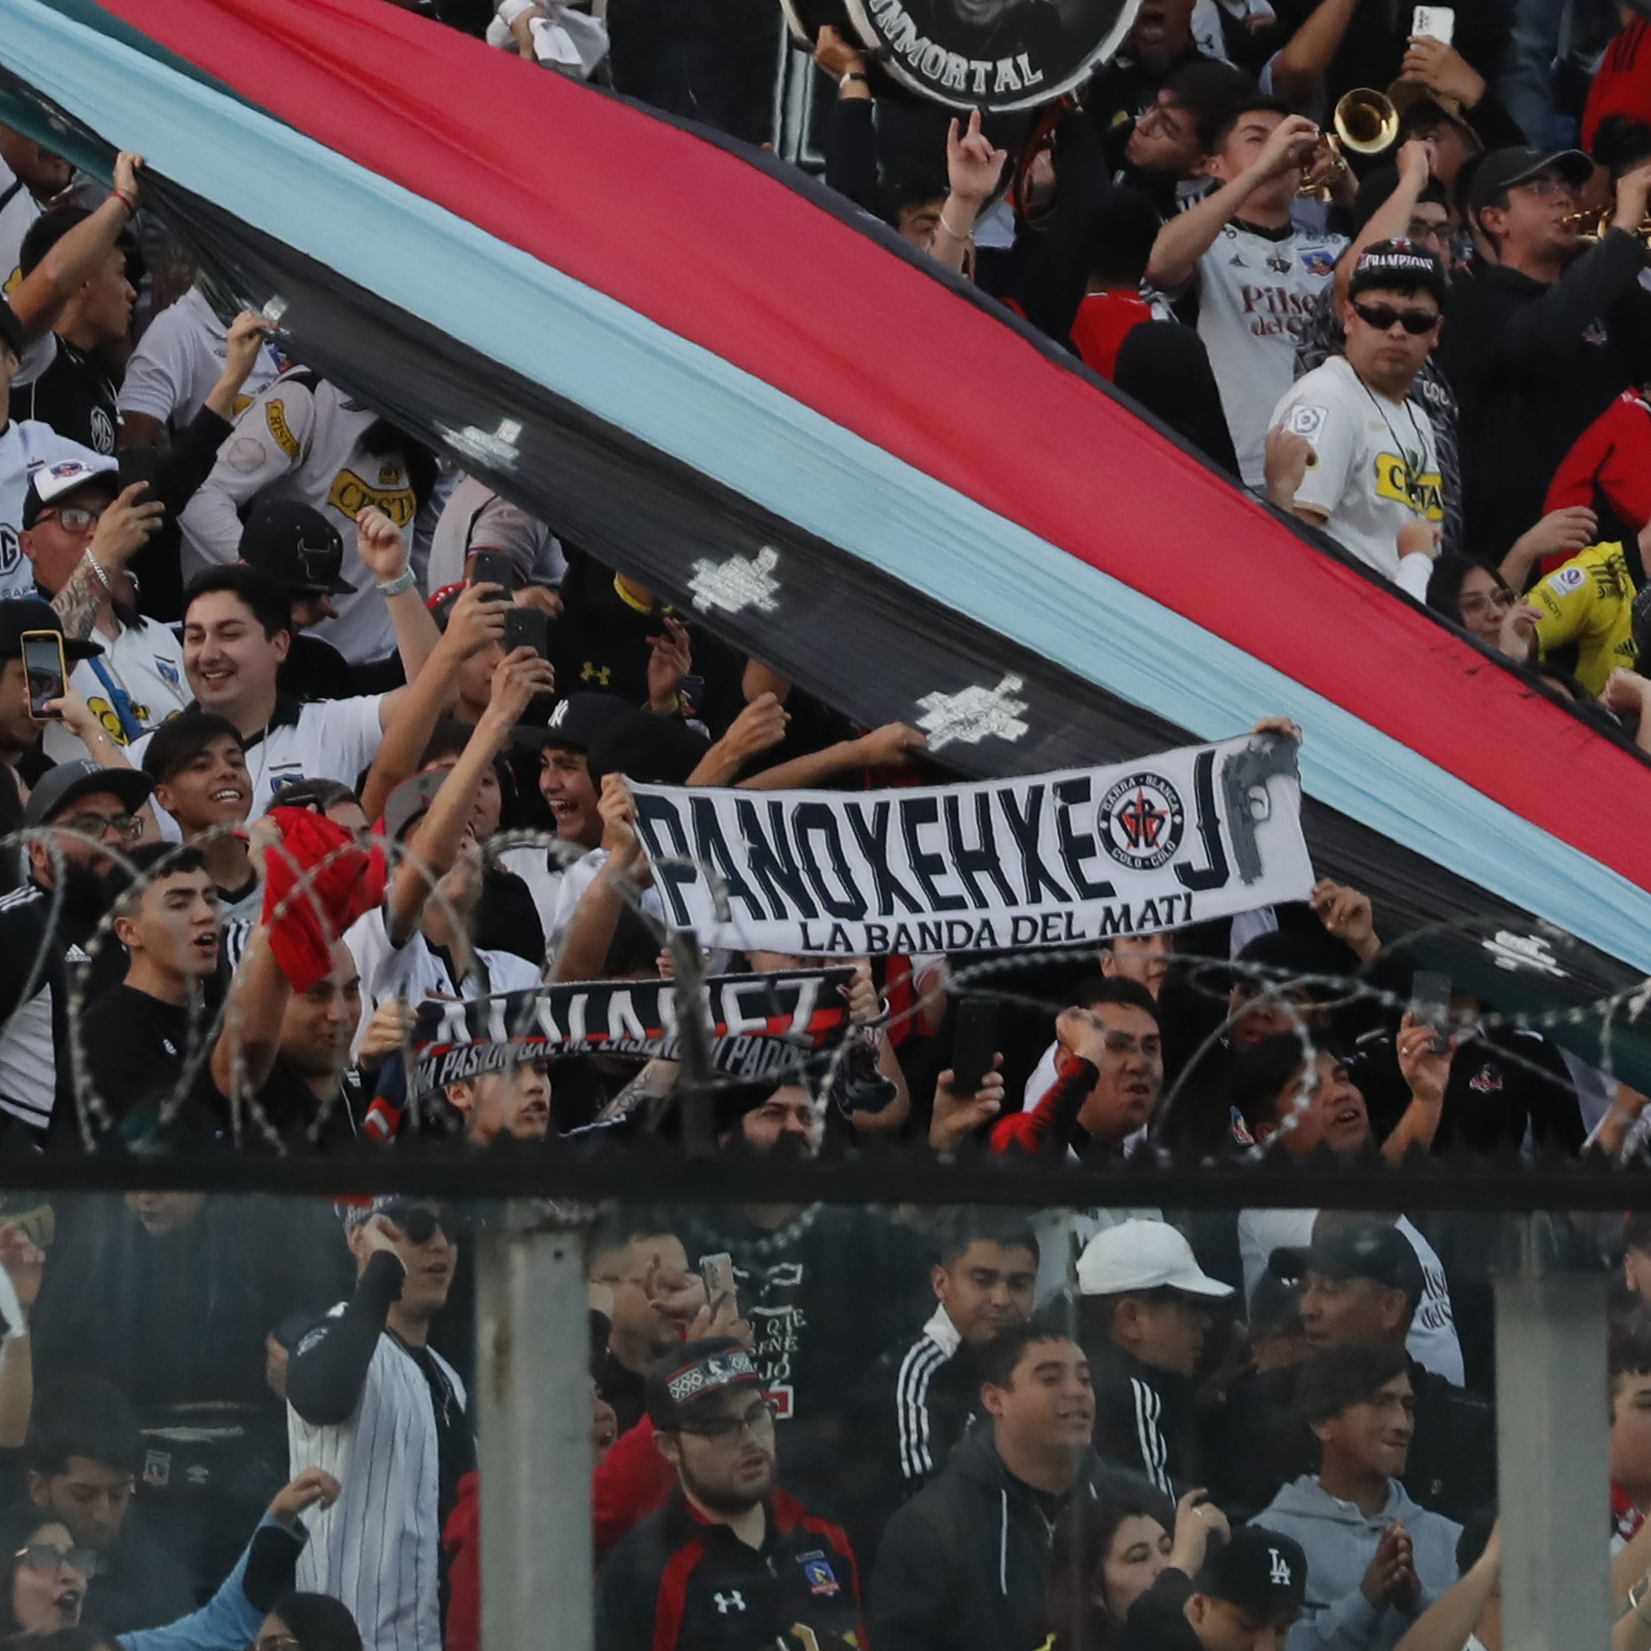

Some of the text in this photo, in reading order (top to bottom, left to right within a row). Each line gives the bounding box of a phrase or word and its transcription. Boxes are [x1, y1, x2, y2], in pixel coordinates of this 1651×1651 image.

[1239, 282, 1320, 316] Pilse
[1111, 846, 1142, 868] COLO
[798, 890, 1193, 955] LA BANDA DEL MATI
[1267, 1548, 1291, 1586] LA
